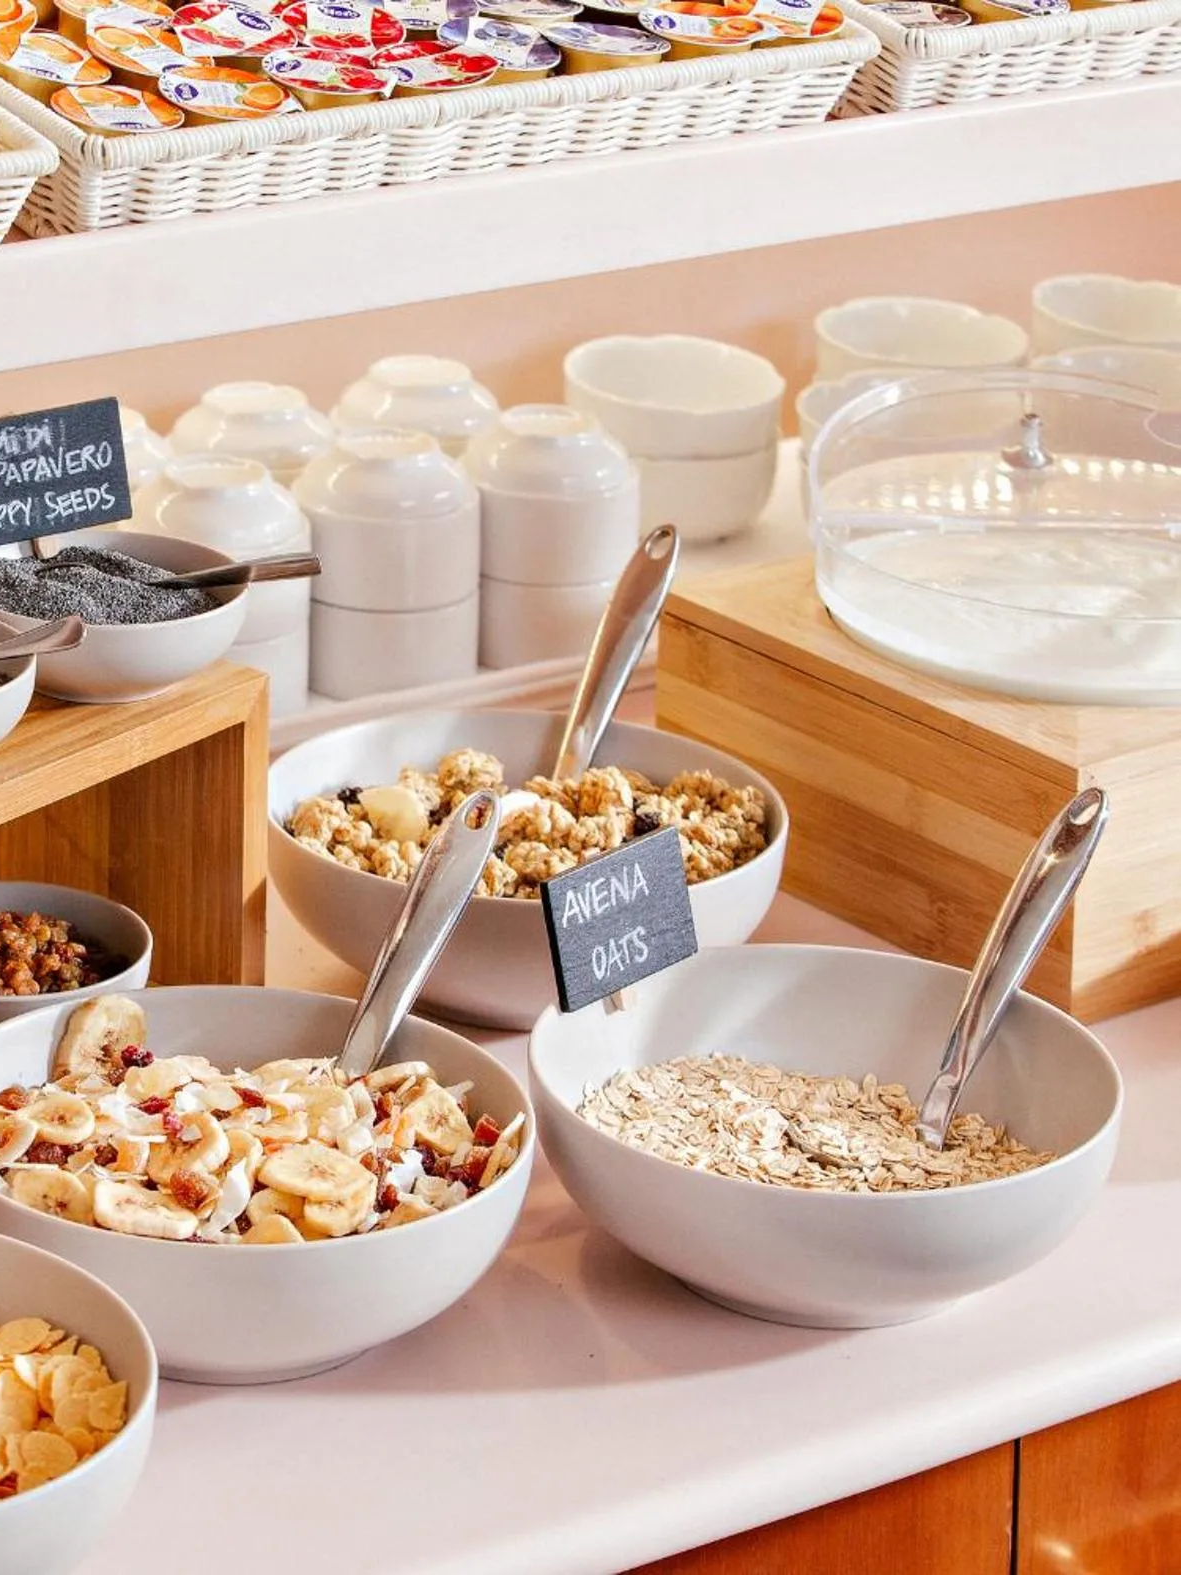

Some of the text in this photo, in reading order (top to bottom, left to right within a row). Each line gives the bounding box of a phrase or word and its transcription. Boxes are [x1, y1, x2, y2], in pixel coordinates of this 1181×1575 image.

[44, 482, 116, 520] SEEDS
[562, 862, 649, 928] AVENA
[592, 926, 648, 980] OATS
